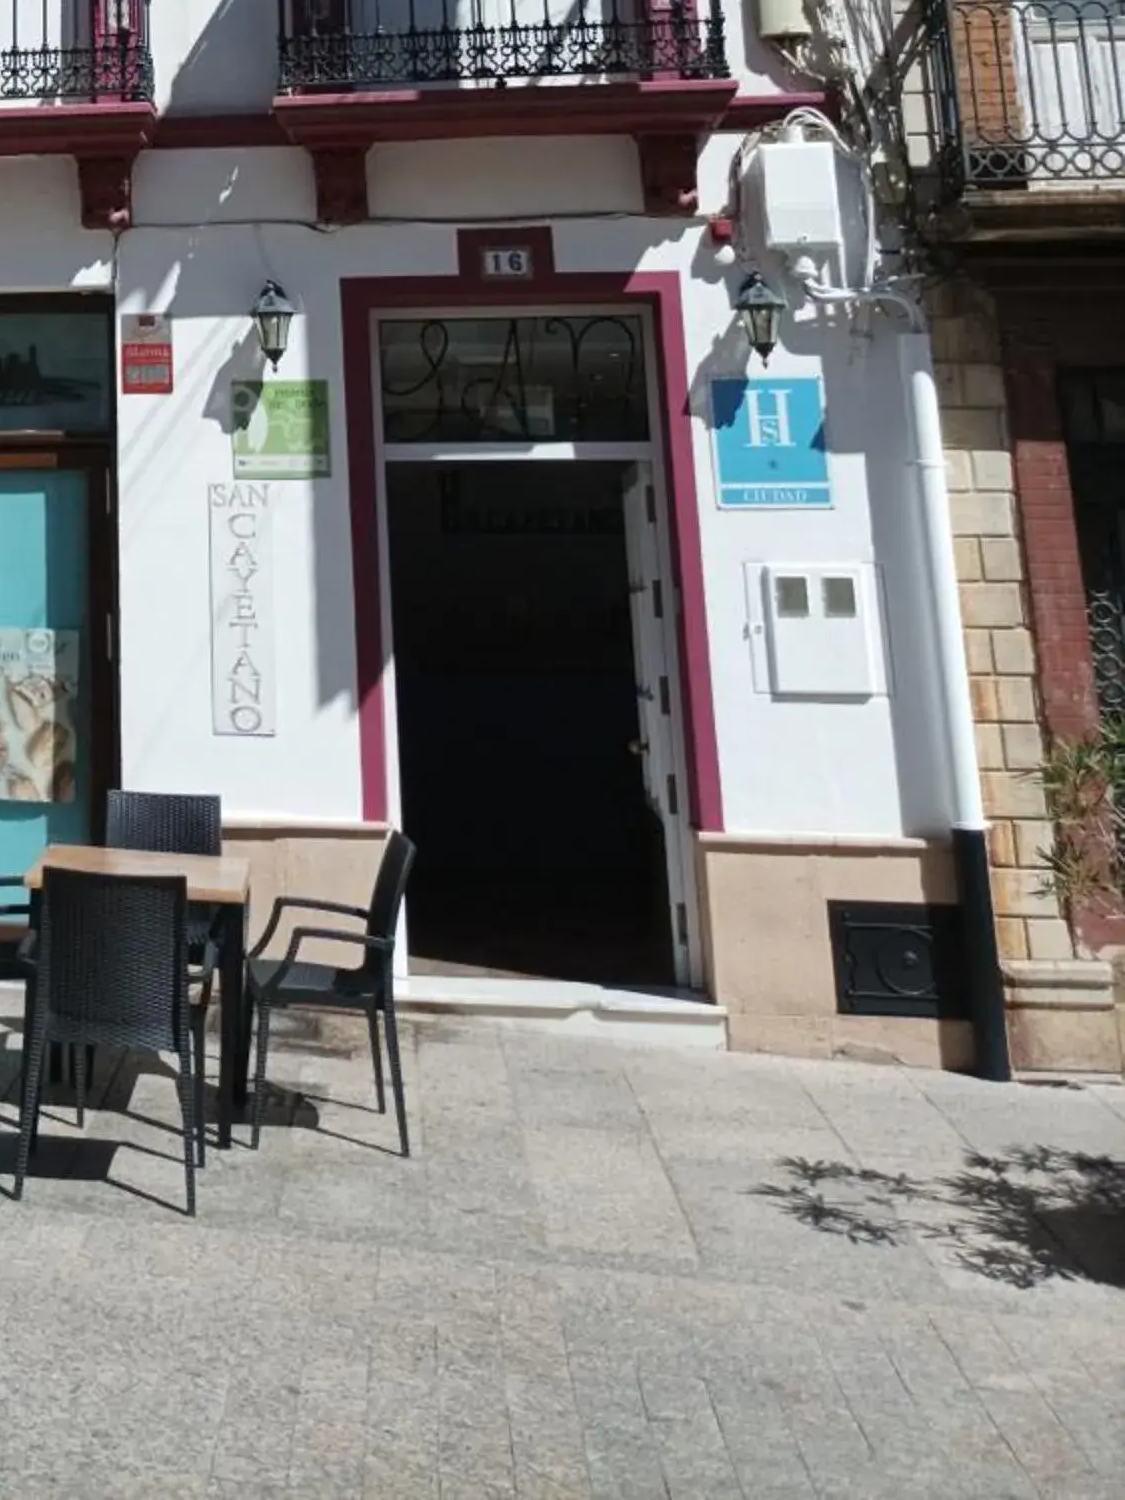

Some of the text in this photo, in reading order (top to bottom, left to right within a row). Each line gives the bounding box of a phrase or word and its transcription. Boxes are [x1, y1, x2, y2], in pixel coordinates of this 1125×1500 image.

[492, 250, 523, 273] 16
[212, 483, 269, 508] SAN
[743, 489, 808, 503] CIUDAD
[227, 512, 263, 733] CAYETANO
